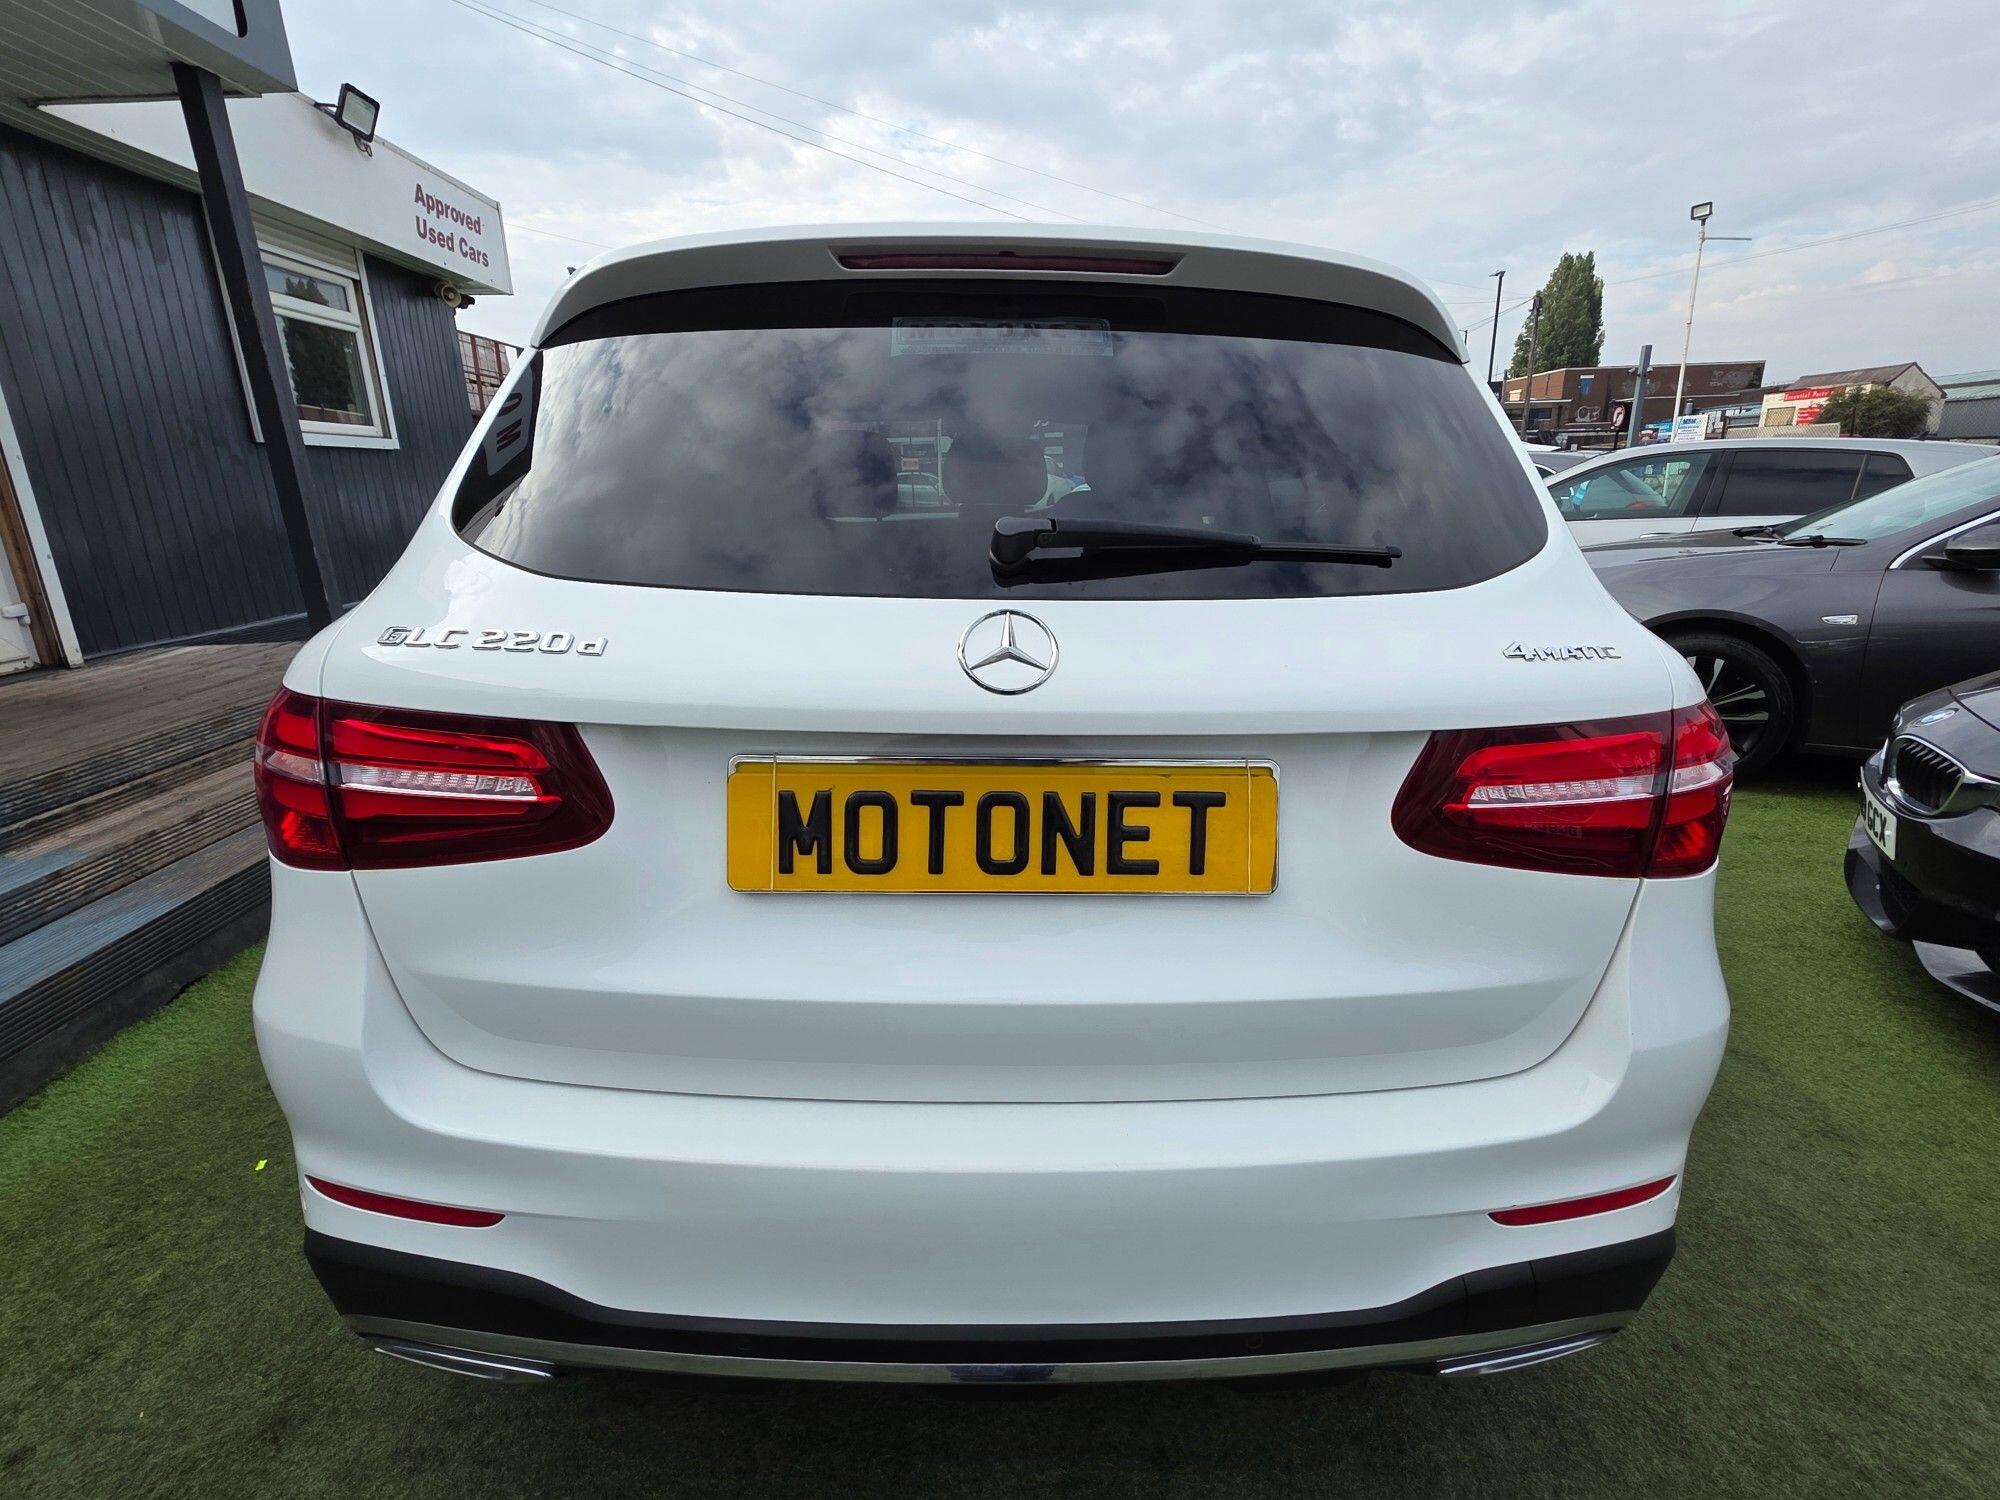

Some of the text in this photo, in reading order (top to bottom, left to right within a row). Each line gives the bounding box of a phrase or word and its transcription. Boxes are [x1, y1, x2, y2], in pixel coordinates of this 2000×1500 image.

[415, 183, 482, 235] Approved
[415, 215, 489, 267] Used Cars
[377, 626, 468, 649] GLC
[1503, 641, 1621, 661] 4MATIC
[778, 789, 1227, 876] MOTONET
